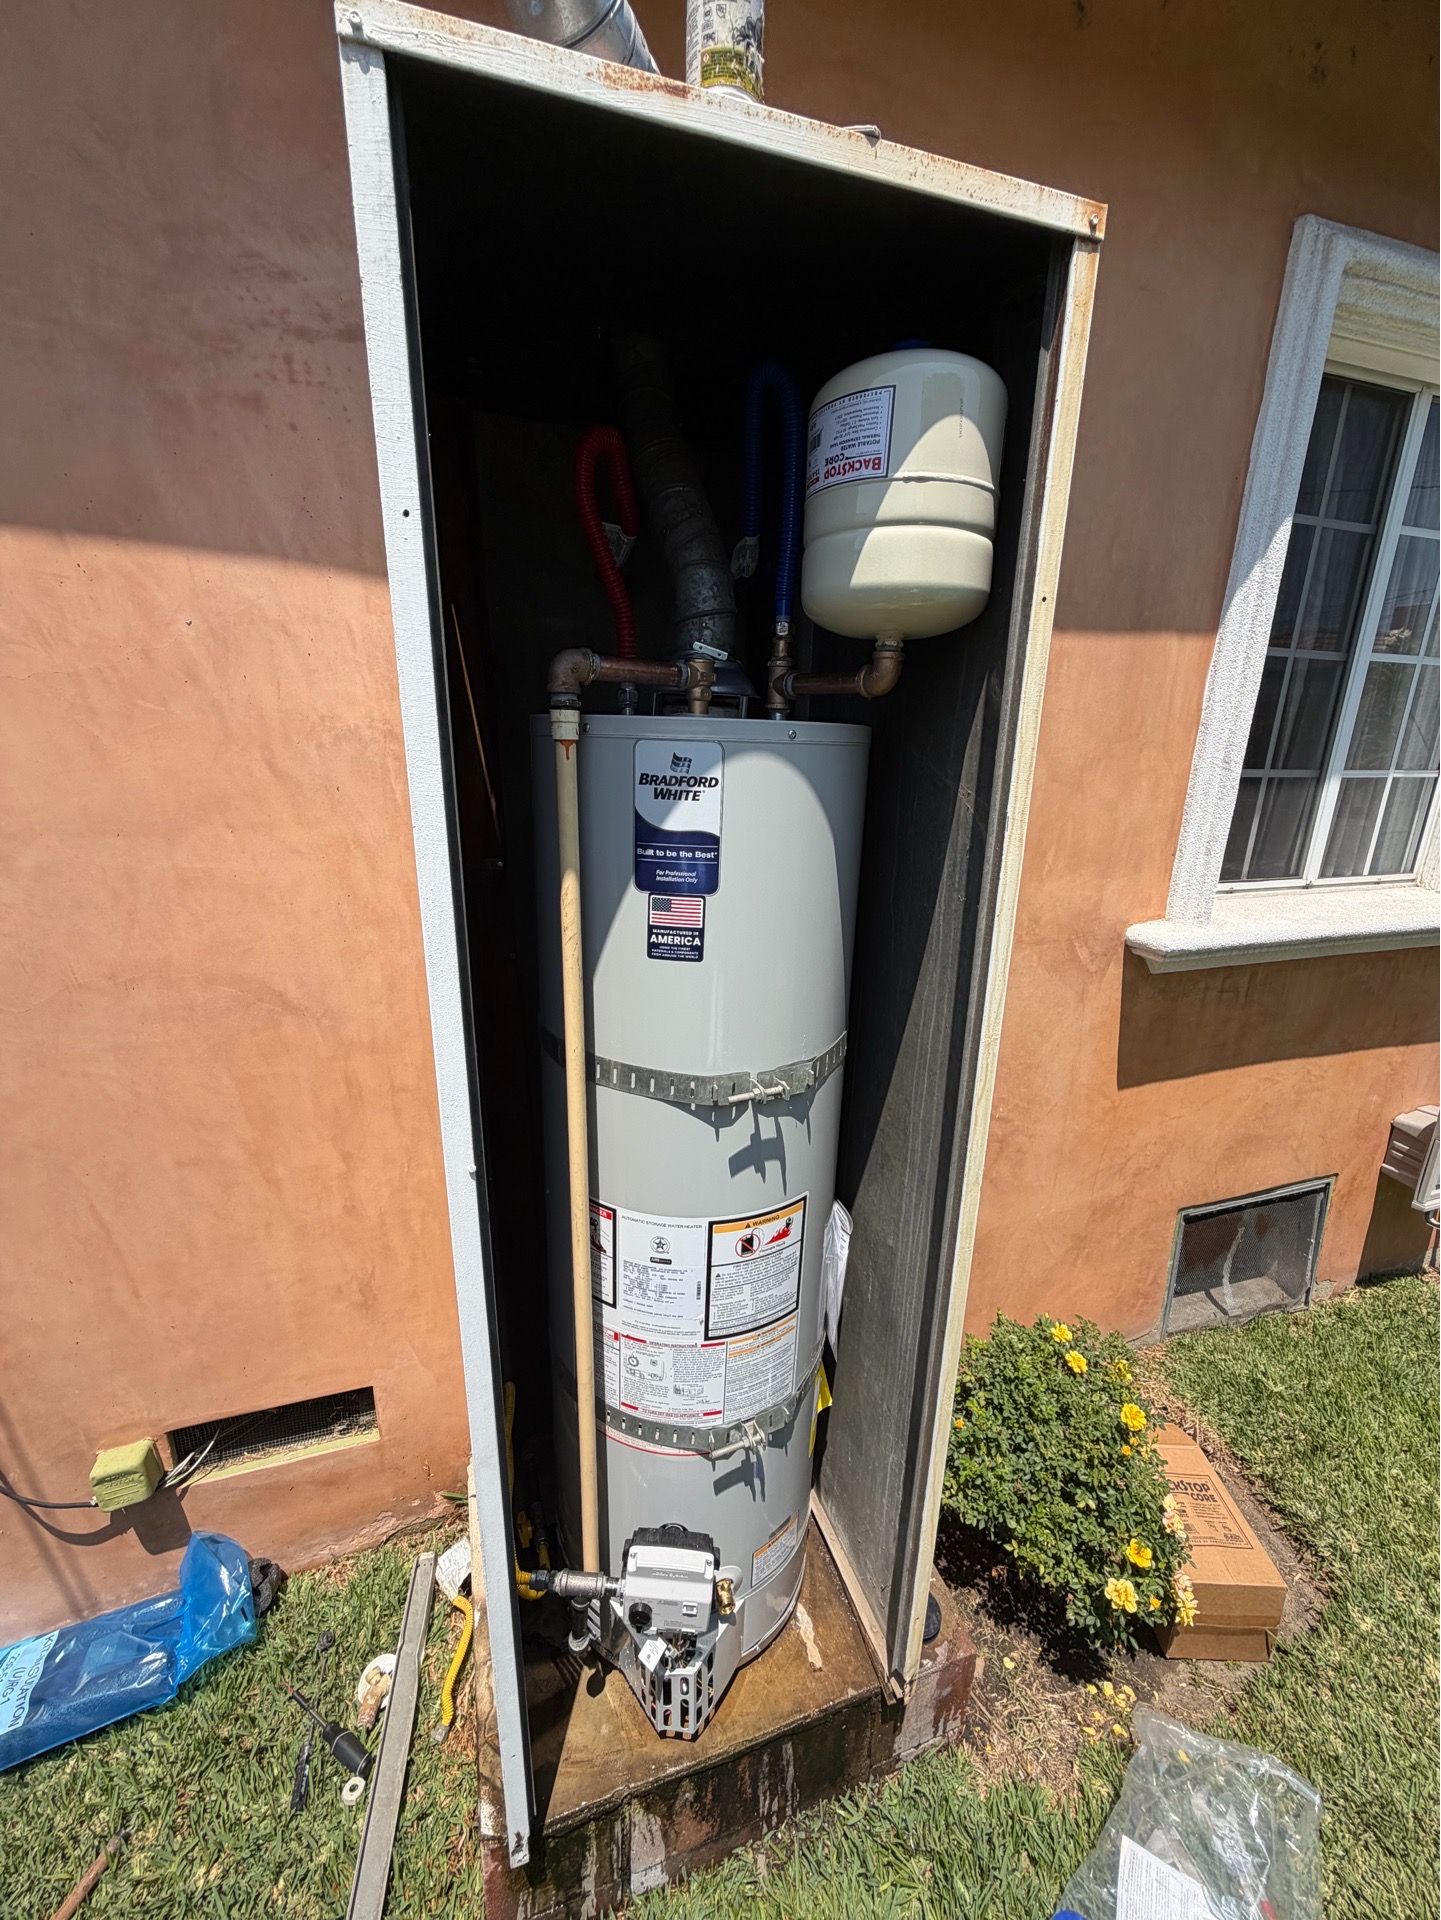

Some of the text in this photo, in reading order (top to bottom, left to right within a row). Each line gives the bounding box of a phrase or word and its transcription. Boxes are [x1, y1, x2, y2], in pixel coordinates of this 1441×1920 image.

[858, 439, 880, 448] POTABLE
[825, 453, 845, 467] CORE
[824, 456, 881, 479] BACKSTOP
[639, 773, 719, 788] BRADFORD
[653, 787, 701, 801] WHITE
[650, 934, 701, 946] AMERICA
[753, 1215, 780, 1227] WARNING
[1169, 1480, 1210, 1493] CKSTOP
[1191, 1493, 1218, 1503] CORE
